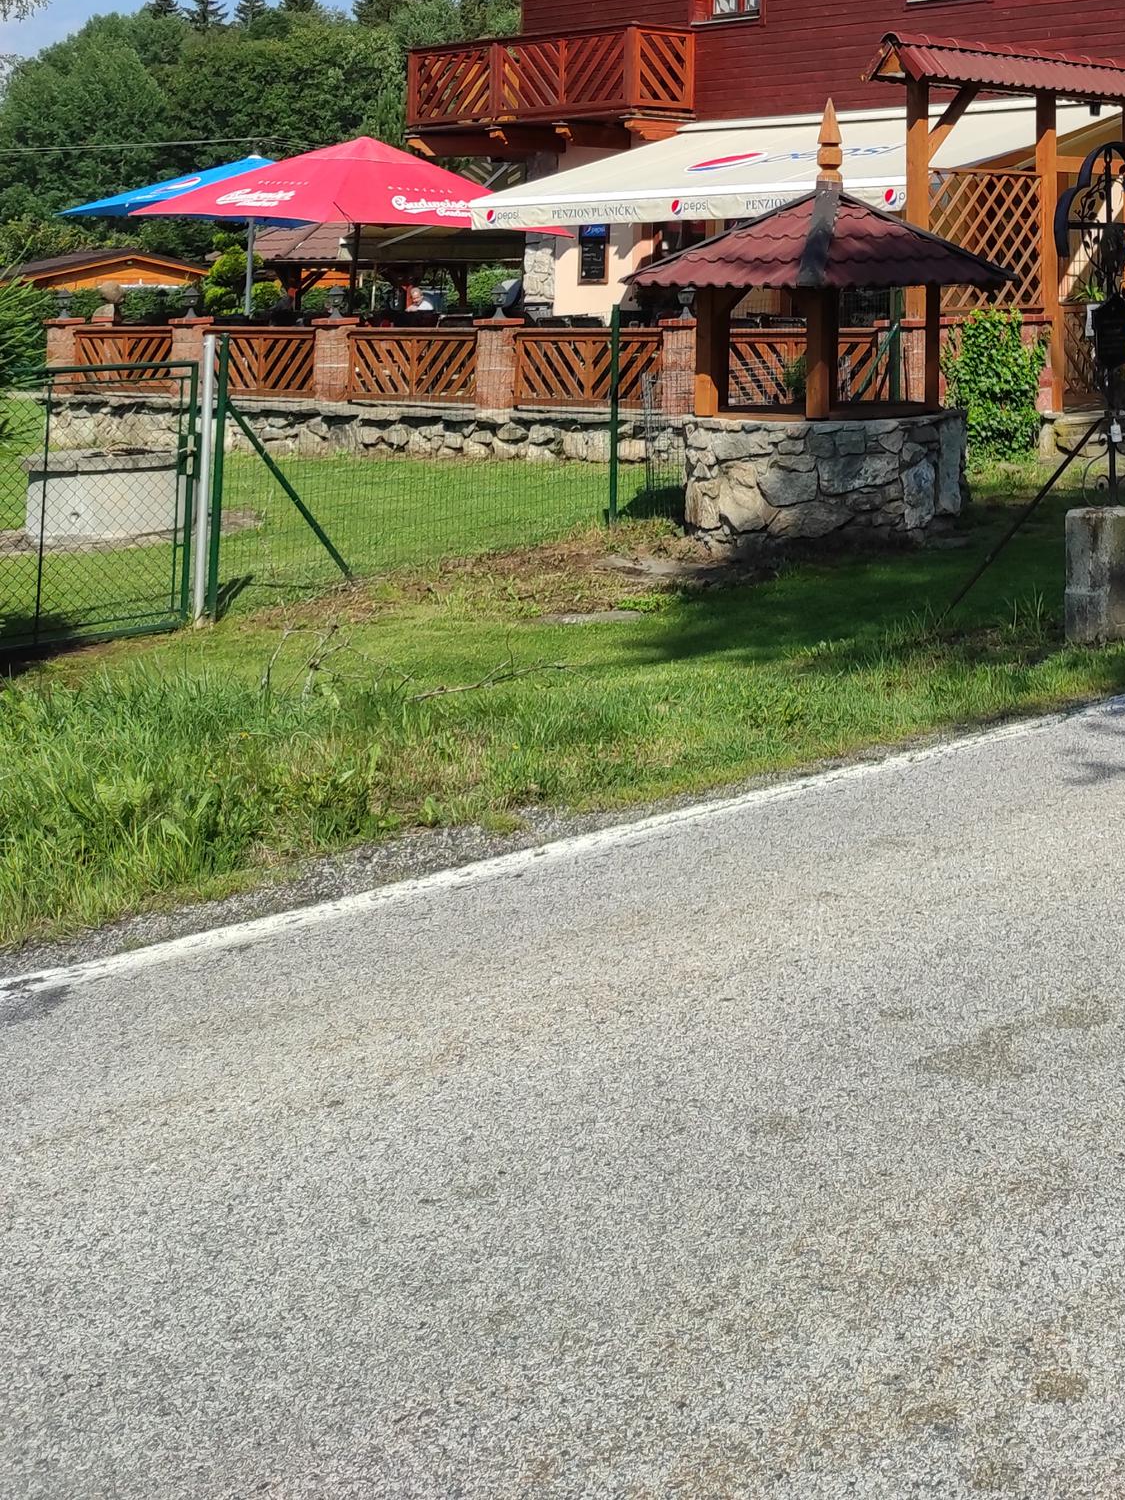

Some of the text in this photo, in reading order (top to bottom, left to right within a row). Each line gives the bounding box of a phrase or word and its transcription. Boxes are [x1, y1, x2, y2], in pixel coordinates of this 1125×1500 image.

[683, 200, 709, 213] pepsi
[497, 210, 520, 222] pepsi
[552, 207, 590, 220] PENZION
